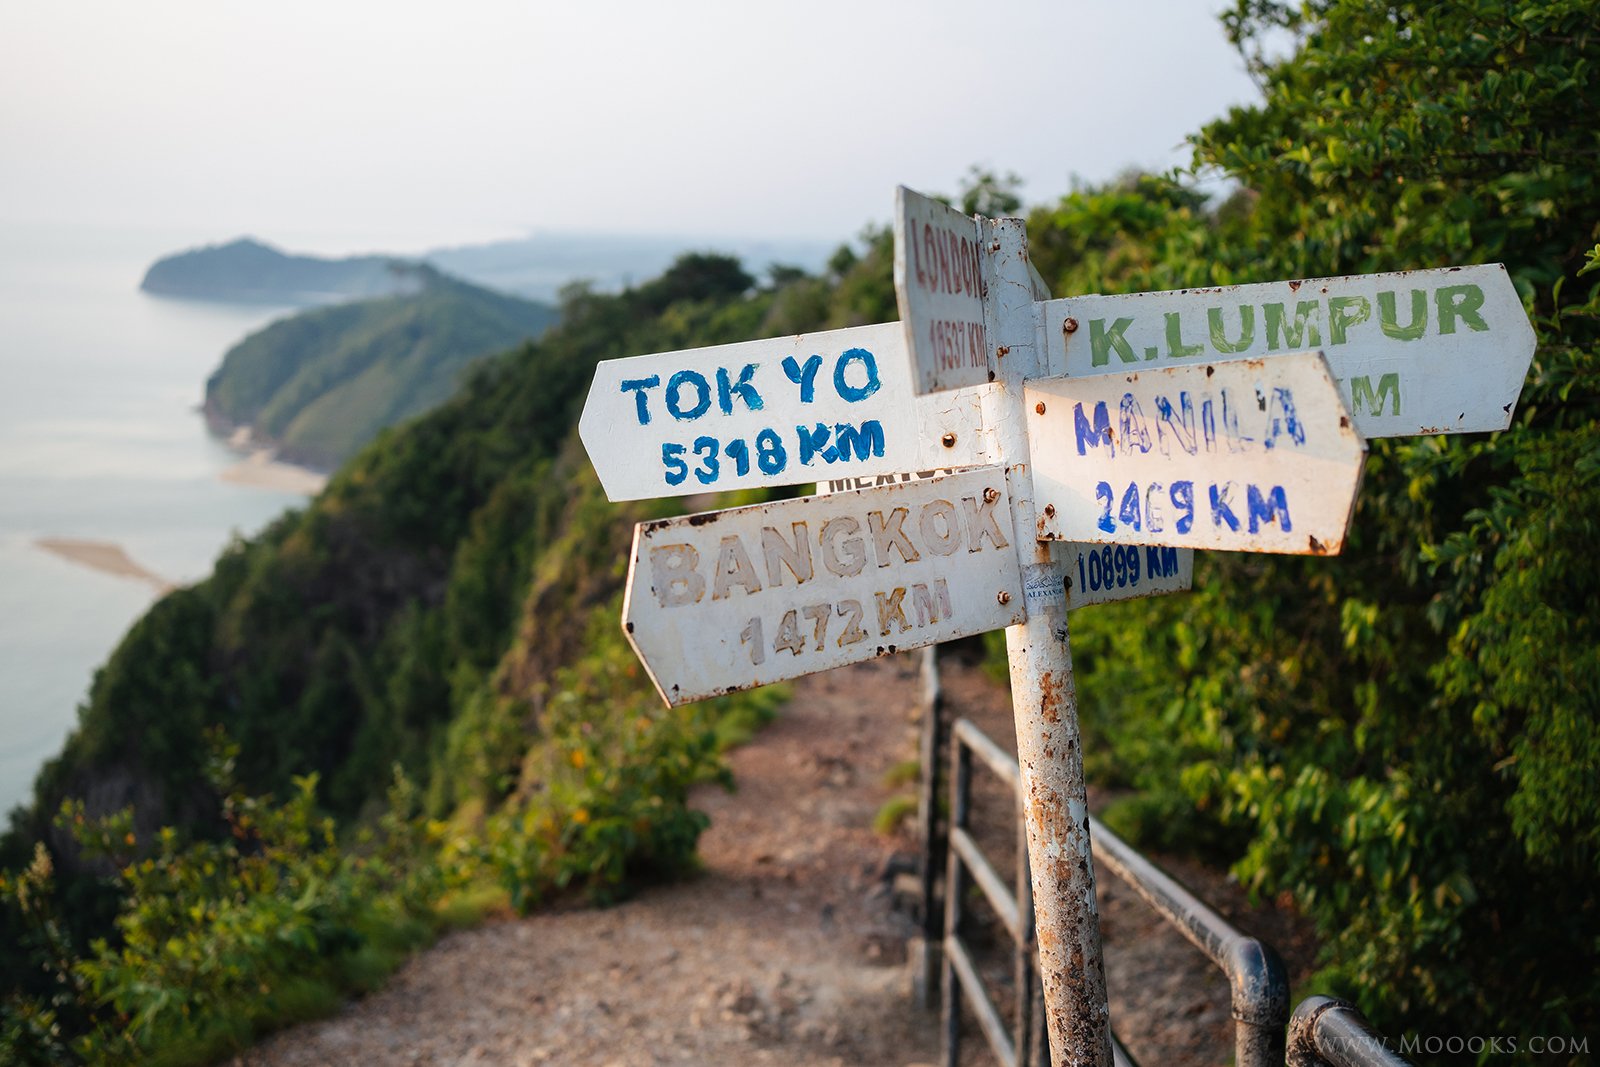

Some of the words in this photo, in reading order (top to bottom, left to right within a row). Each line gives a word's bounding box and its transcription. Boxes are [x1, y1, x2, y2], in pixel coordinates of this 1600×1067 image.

[911, 218, 982, 298] LONDON
[1089, 284, 1490, 368] K.LUMPUR
[1336, 373, 1401, 417] M
[662, 427, 788, 486] 5318
[796, 419, 886, 467] KM
[1209, 480, 1293, 534] KM
[649, 495, 1009, 608] BANGKOK
[1078, 545, 1140, 593] 10899
[1146, 546, 1178, 579] KM
[740, 600, 869, 665] 1472
[874, 577, 953, 637] KM
